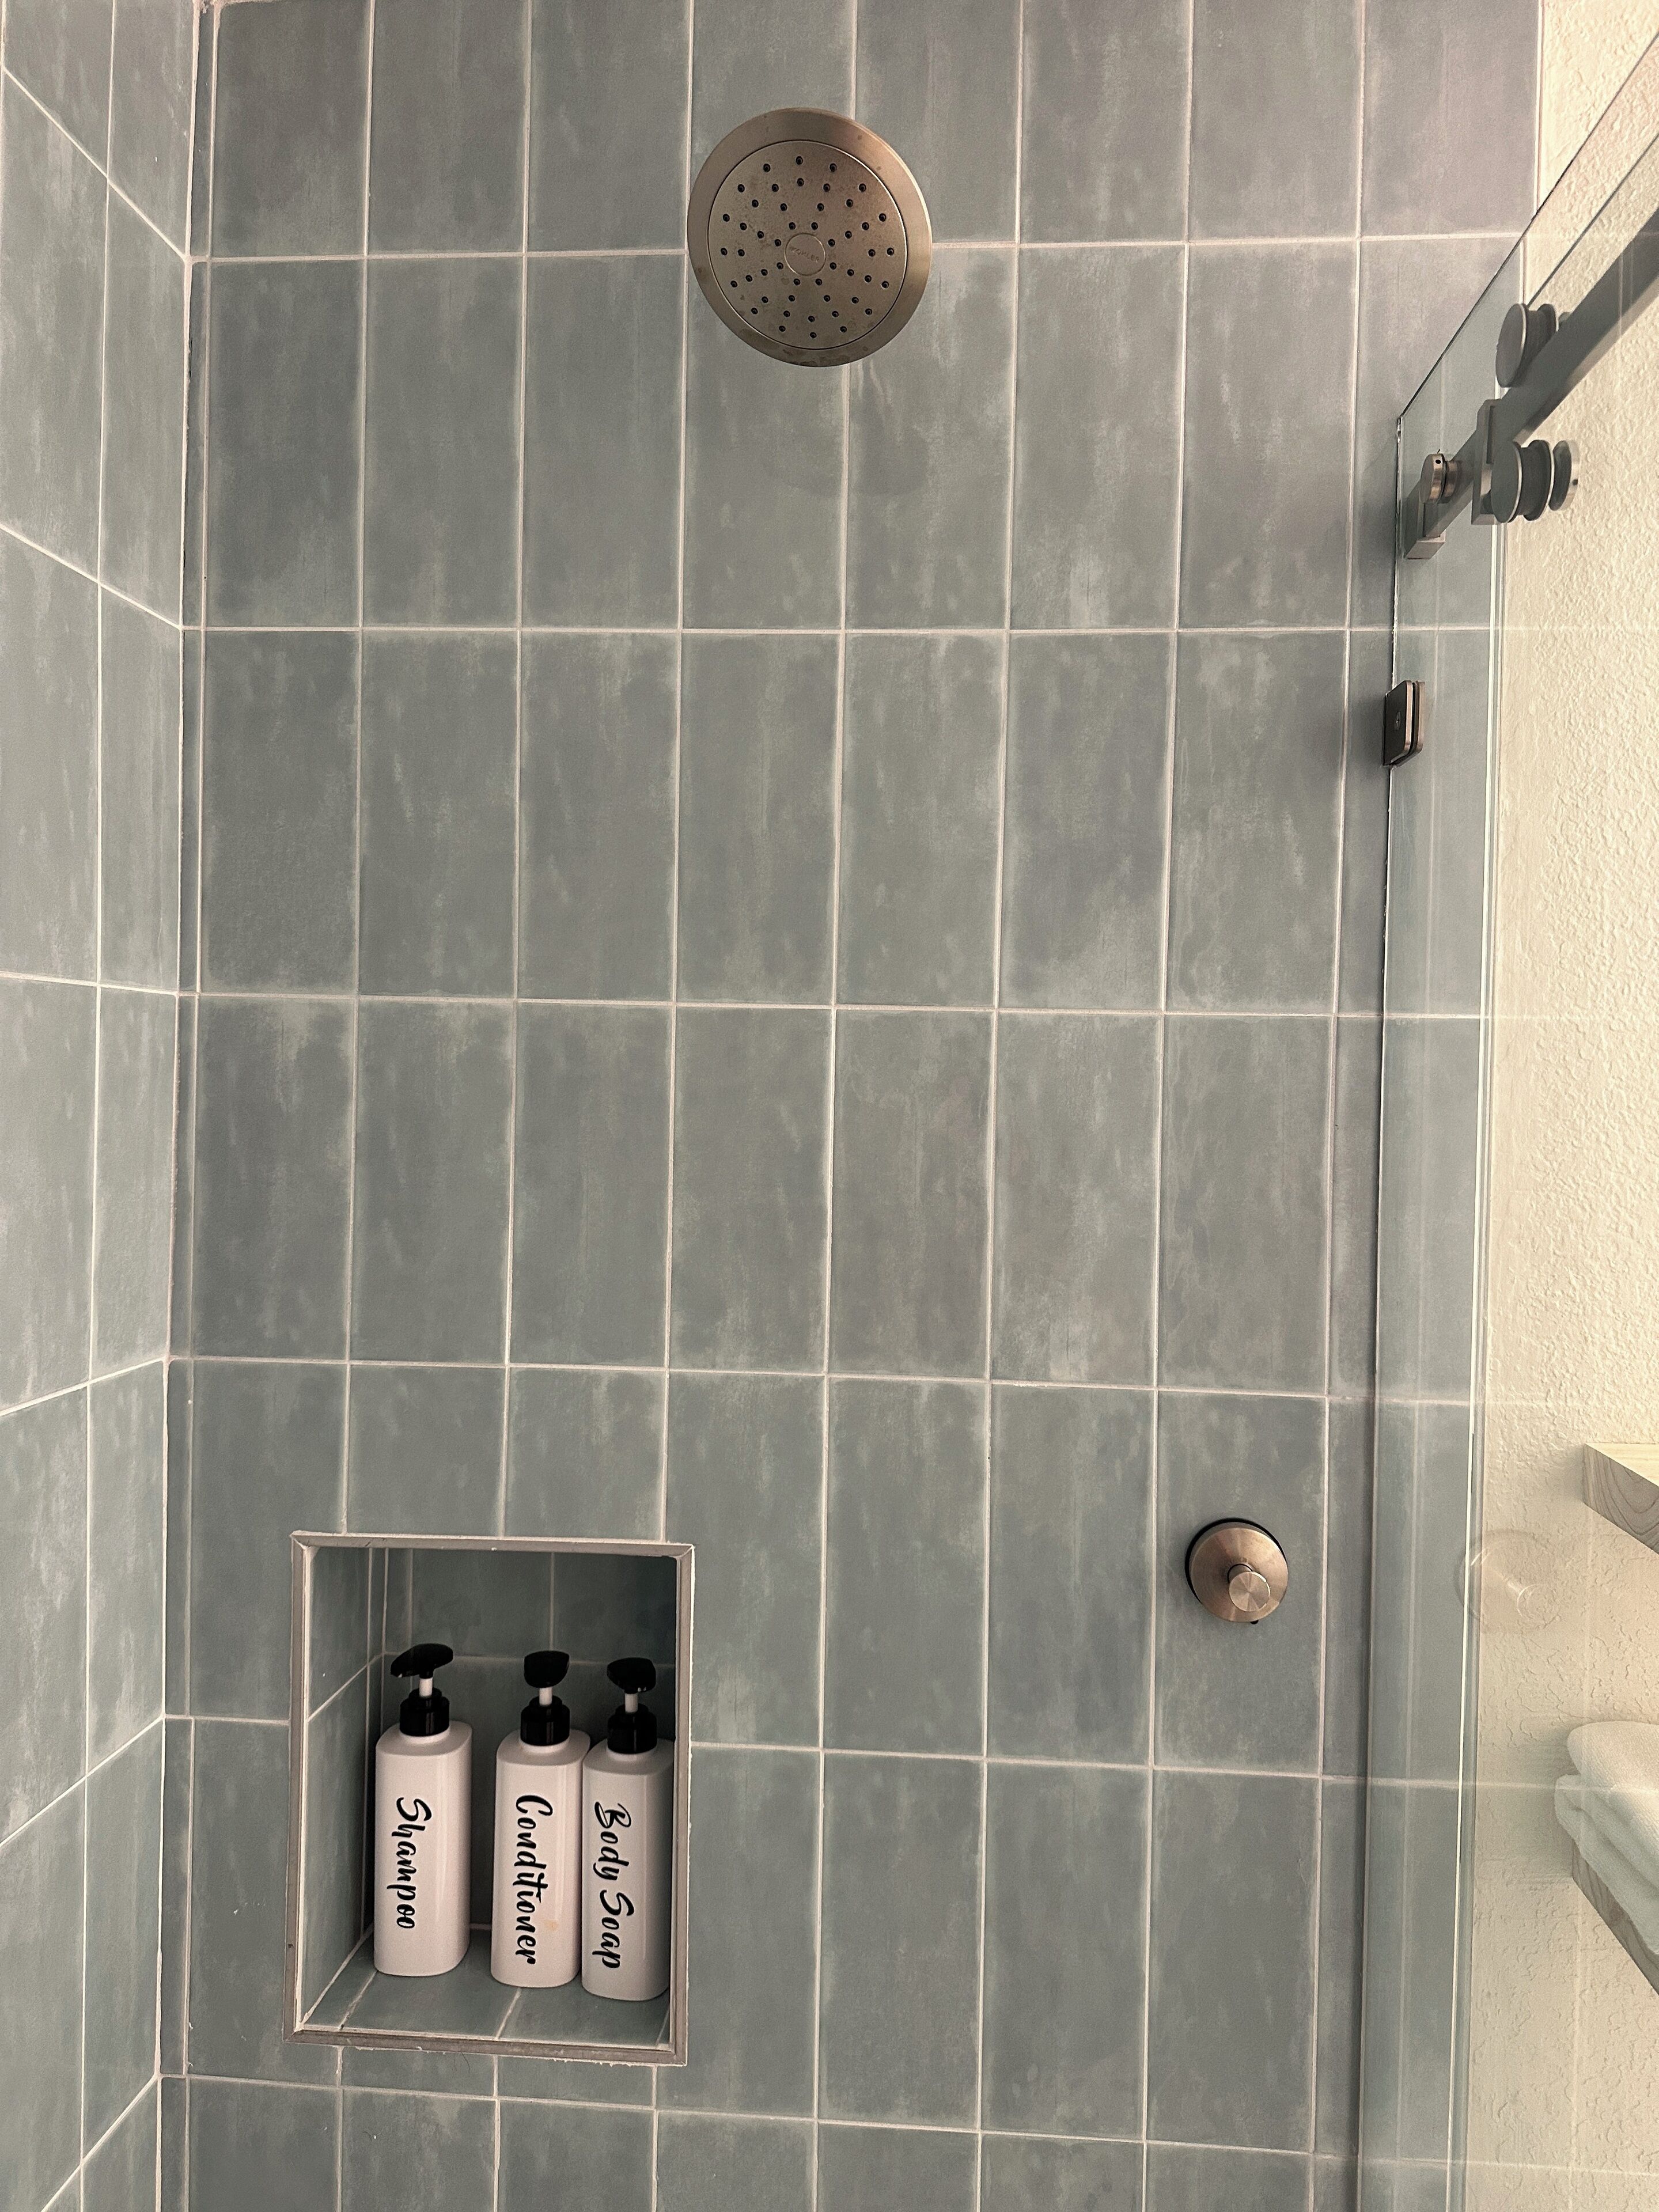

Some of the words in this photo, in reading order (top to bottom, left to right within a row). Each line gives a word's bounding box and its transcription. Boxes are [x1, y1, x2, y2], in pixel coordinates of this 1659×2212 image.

[387, 1797, 432, 1929] Shampoo
[512, 1794, 553, 1965] Conditioner
[593, 1801, 632, 1881] Body
[592, 1889, 635, 1969] Soap
